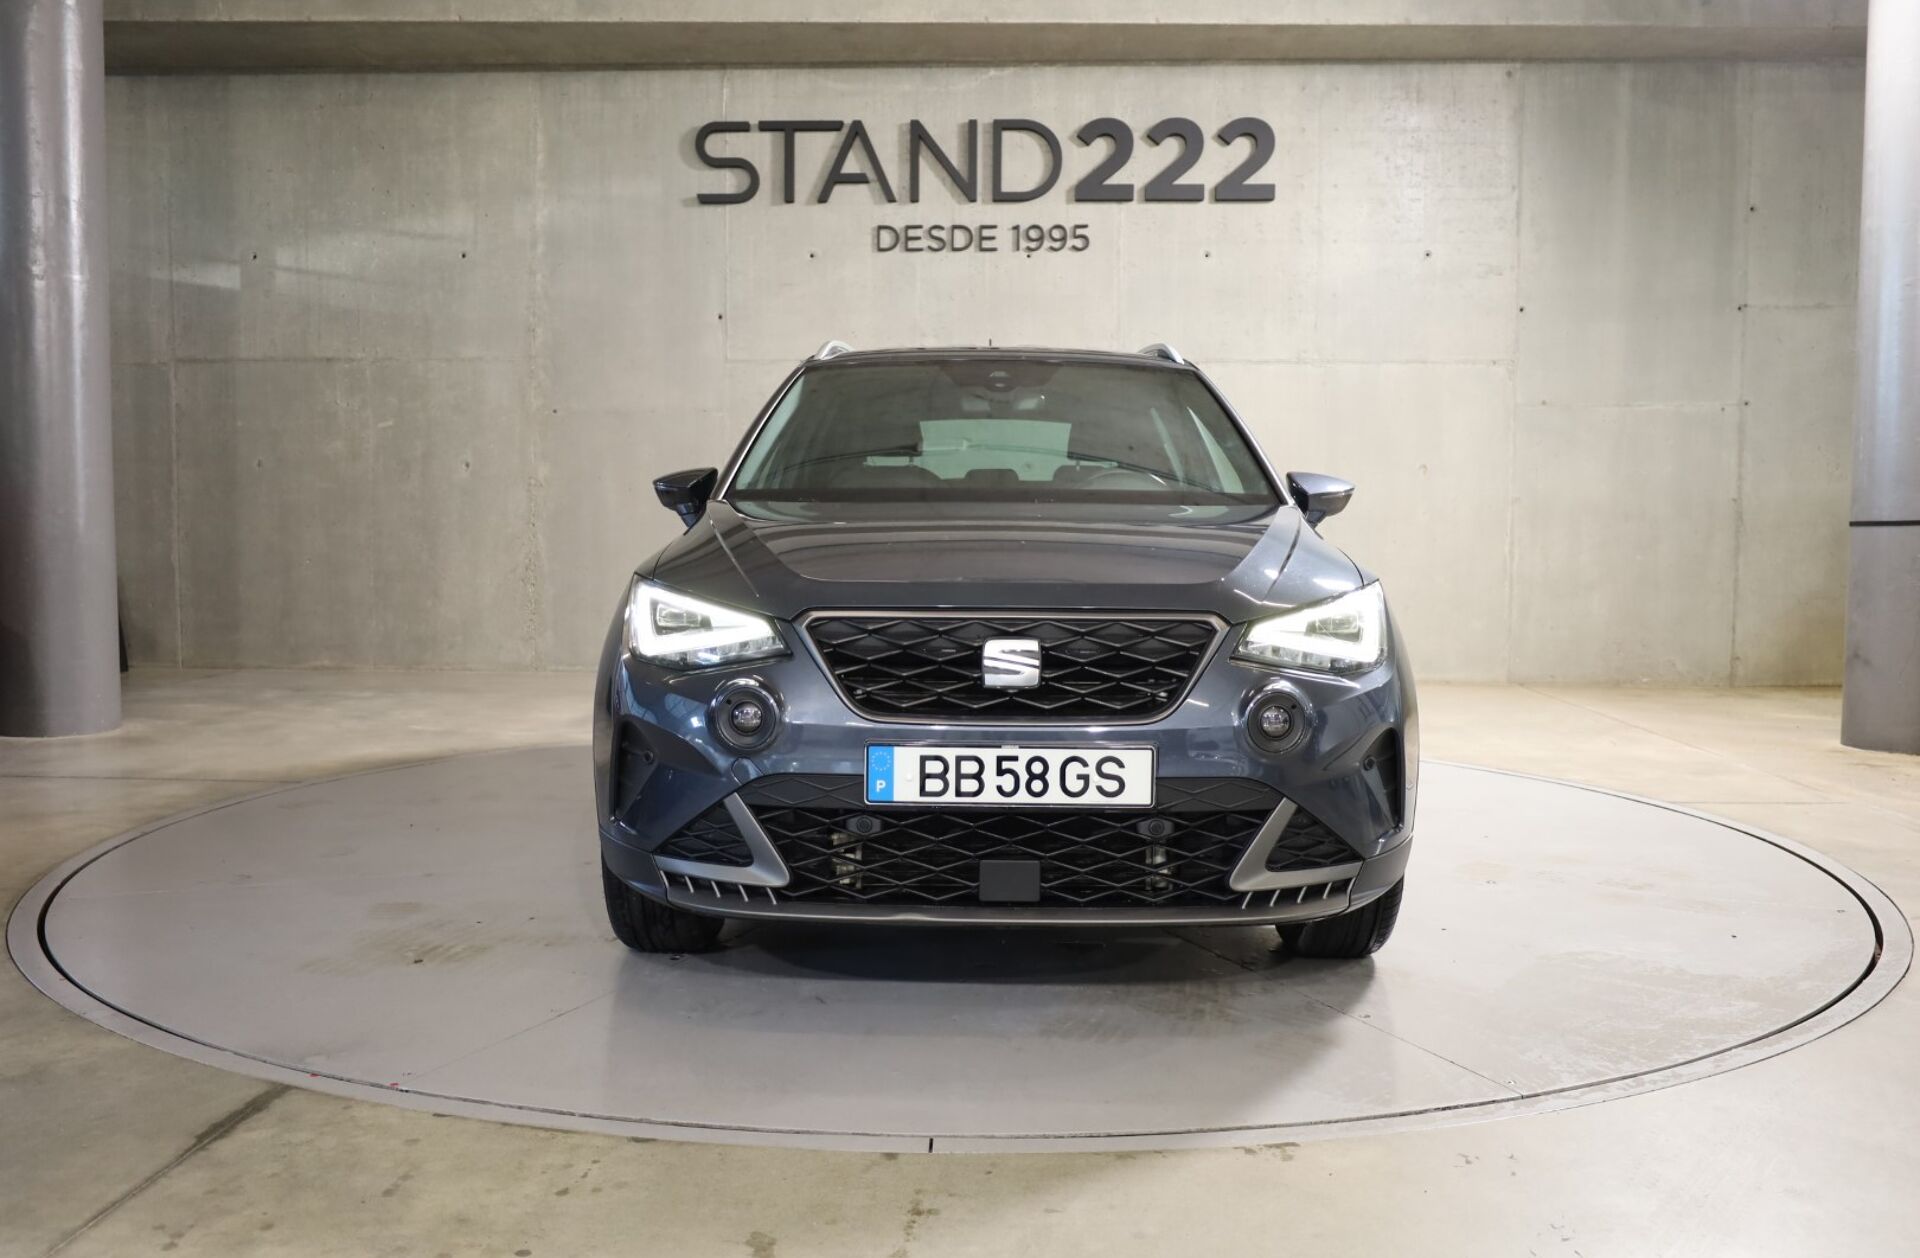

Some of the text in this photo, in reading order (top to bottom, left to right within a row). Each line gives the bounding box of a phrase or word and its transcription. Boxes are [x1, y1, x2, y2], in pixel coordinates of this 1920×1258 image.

[695, 117, 1276, 204] STAND222
[875, 224, 1091, 253] DESDE 1995
[876, 780, 886, 792] P
[919, 754, 1126, 798] BB 58 GS
